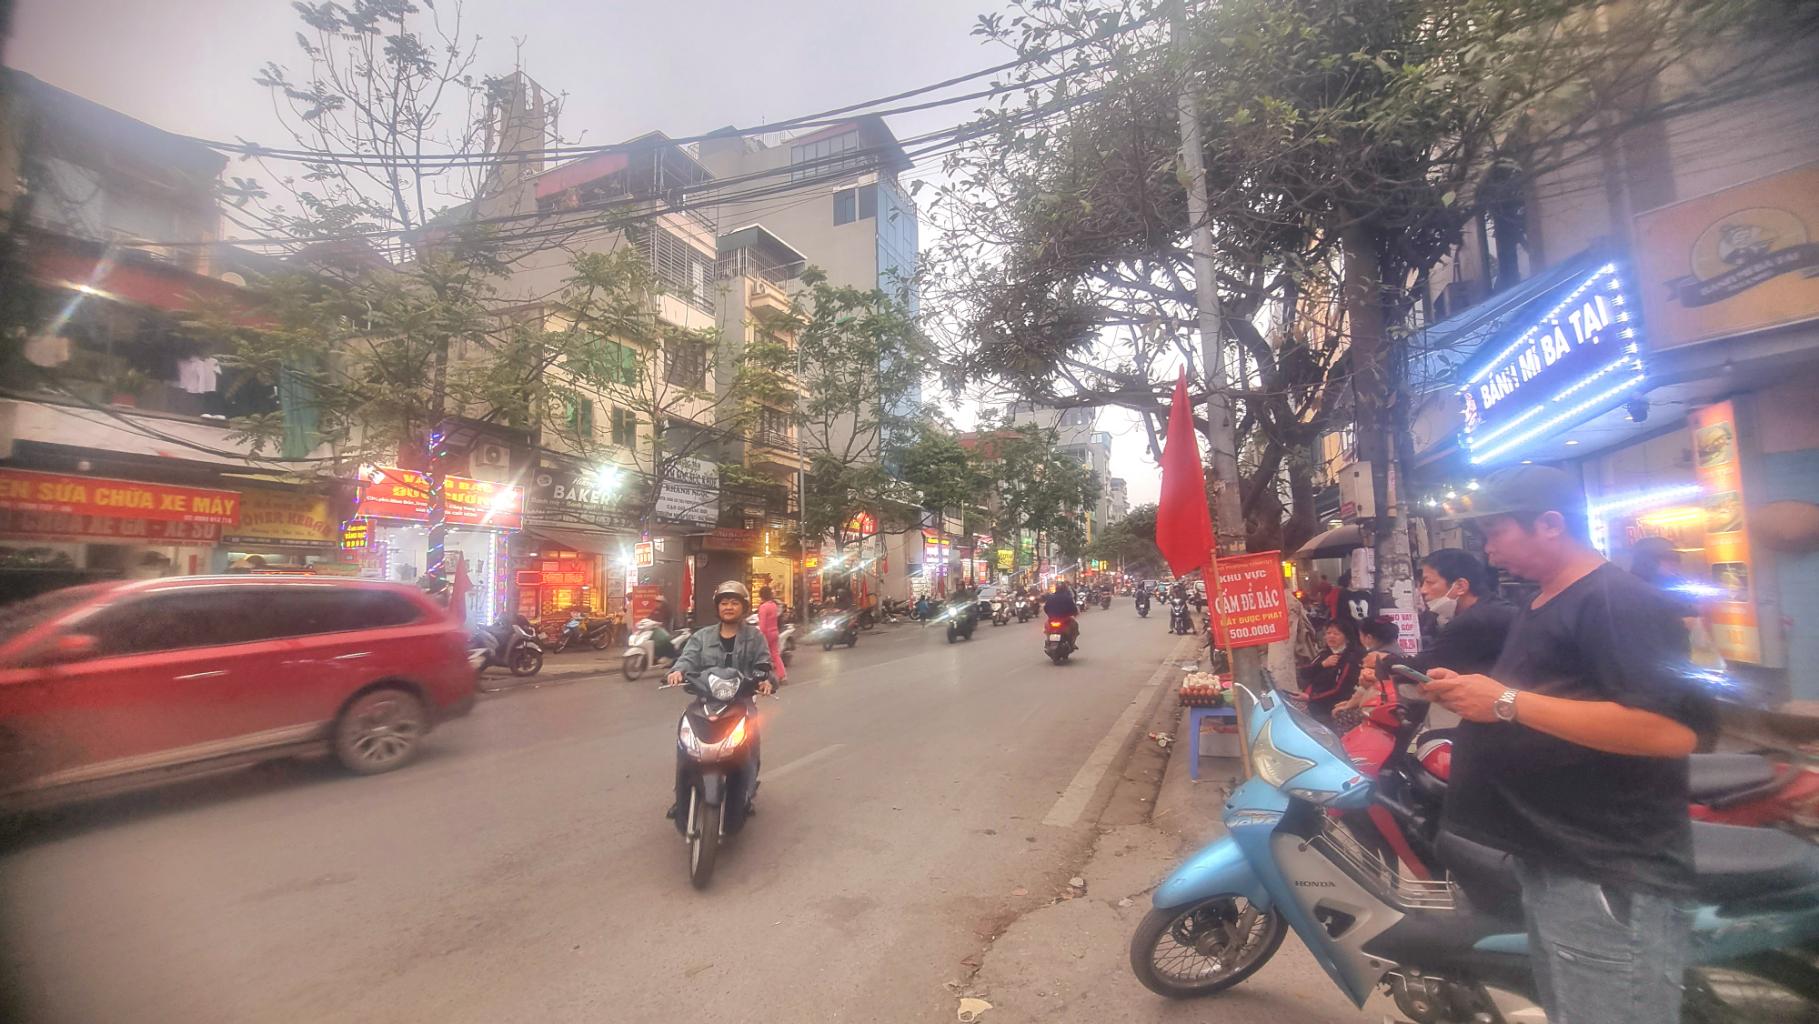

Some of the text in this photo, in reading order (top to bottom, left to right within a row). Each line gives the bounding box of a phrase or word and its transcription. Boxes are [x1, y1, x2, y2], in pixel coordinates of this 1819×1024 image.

[1480, 362, 1520, 409] BÁNH
[1540, 318, 1571, 366] BÀ
[1568, 295, 1609, 345] TẠI
[95, 484, 154, 509] CHỮA
[160, 494, 187, 512] XE
[192, 495, 234, 515] MÁY
[553, 484, 623, 506] BAKERY
[1220, 569, 1267, 583] KHU VỰC
[1257, 585, 1280, 609] RÁC
